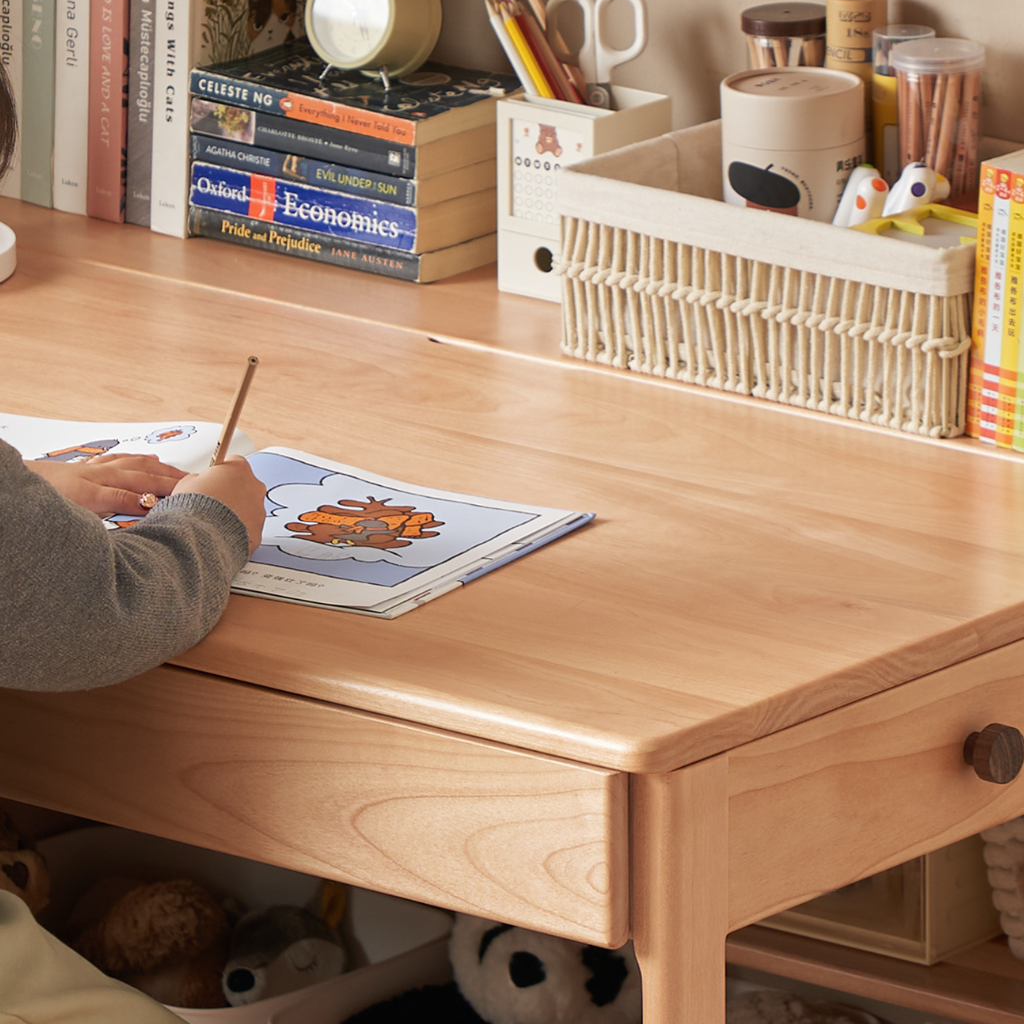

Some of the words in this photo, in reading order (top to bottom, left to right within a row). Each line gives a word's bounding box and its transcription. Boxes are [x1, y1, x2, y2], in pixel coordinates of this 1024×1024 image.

[102, 7, 112, 22] IS
[66, 27, 78, 67] Gerli
[101, 25, 112, 63] LOVE
[165, 39, 176, 77] With
[101, 67, 111, 99] AND
[198, 78, 249, 101] CELESTE
[252, 90, 273, 107] NG
[101, 104, 110, 112] A
[165, 84, 176, 123] Cats
[100, 116, 110, 147] CAT
[298, 104, 341, 123] Everything
[347, 113, 371, 129] Never
[373, 119, 390, 132] Told
[392, 123, 407, 136] You
[205, 145, 236, 160] AGATHA
[237, 149, 271, 167] CHRISTIE
[316, 168, 337, 183] EVIL
[338, 172, 372, 190] UNDER
[378, 180, 398, 196] SUN
[197, 176, 248, 202] Oxford
[282, 191, 400, 239] Economics
[220, 219, 251, 239] Pride
[252, 231, 267, 243] and
[268, 230, 322, 254] Prejudice
[331, 247, 358, 260] JANE
[361, 252, 404, 270] AUSTEN
[1007, 276, 1018, 337] 雅各布出去玩
